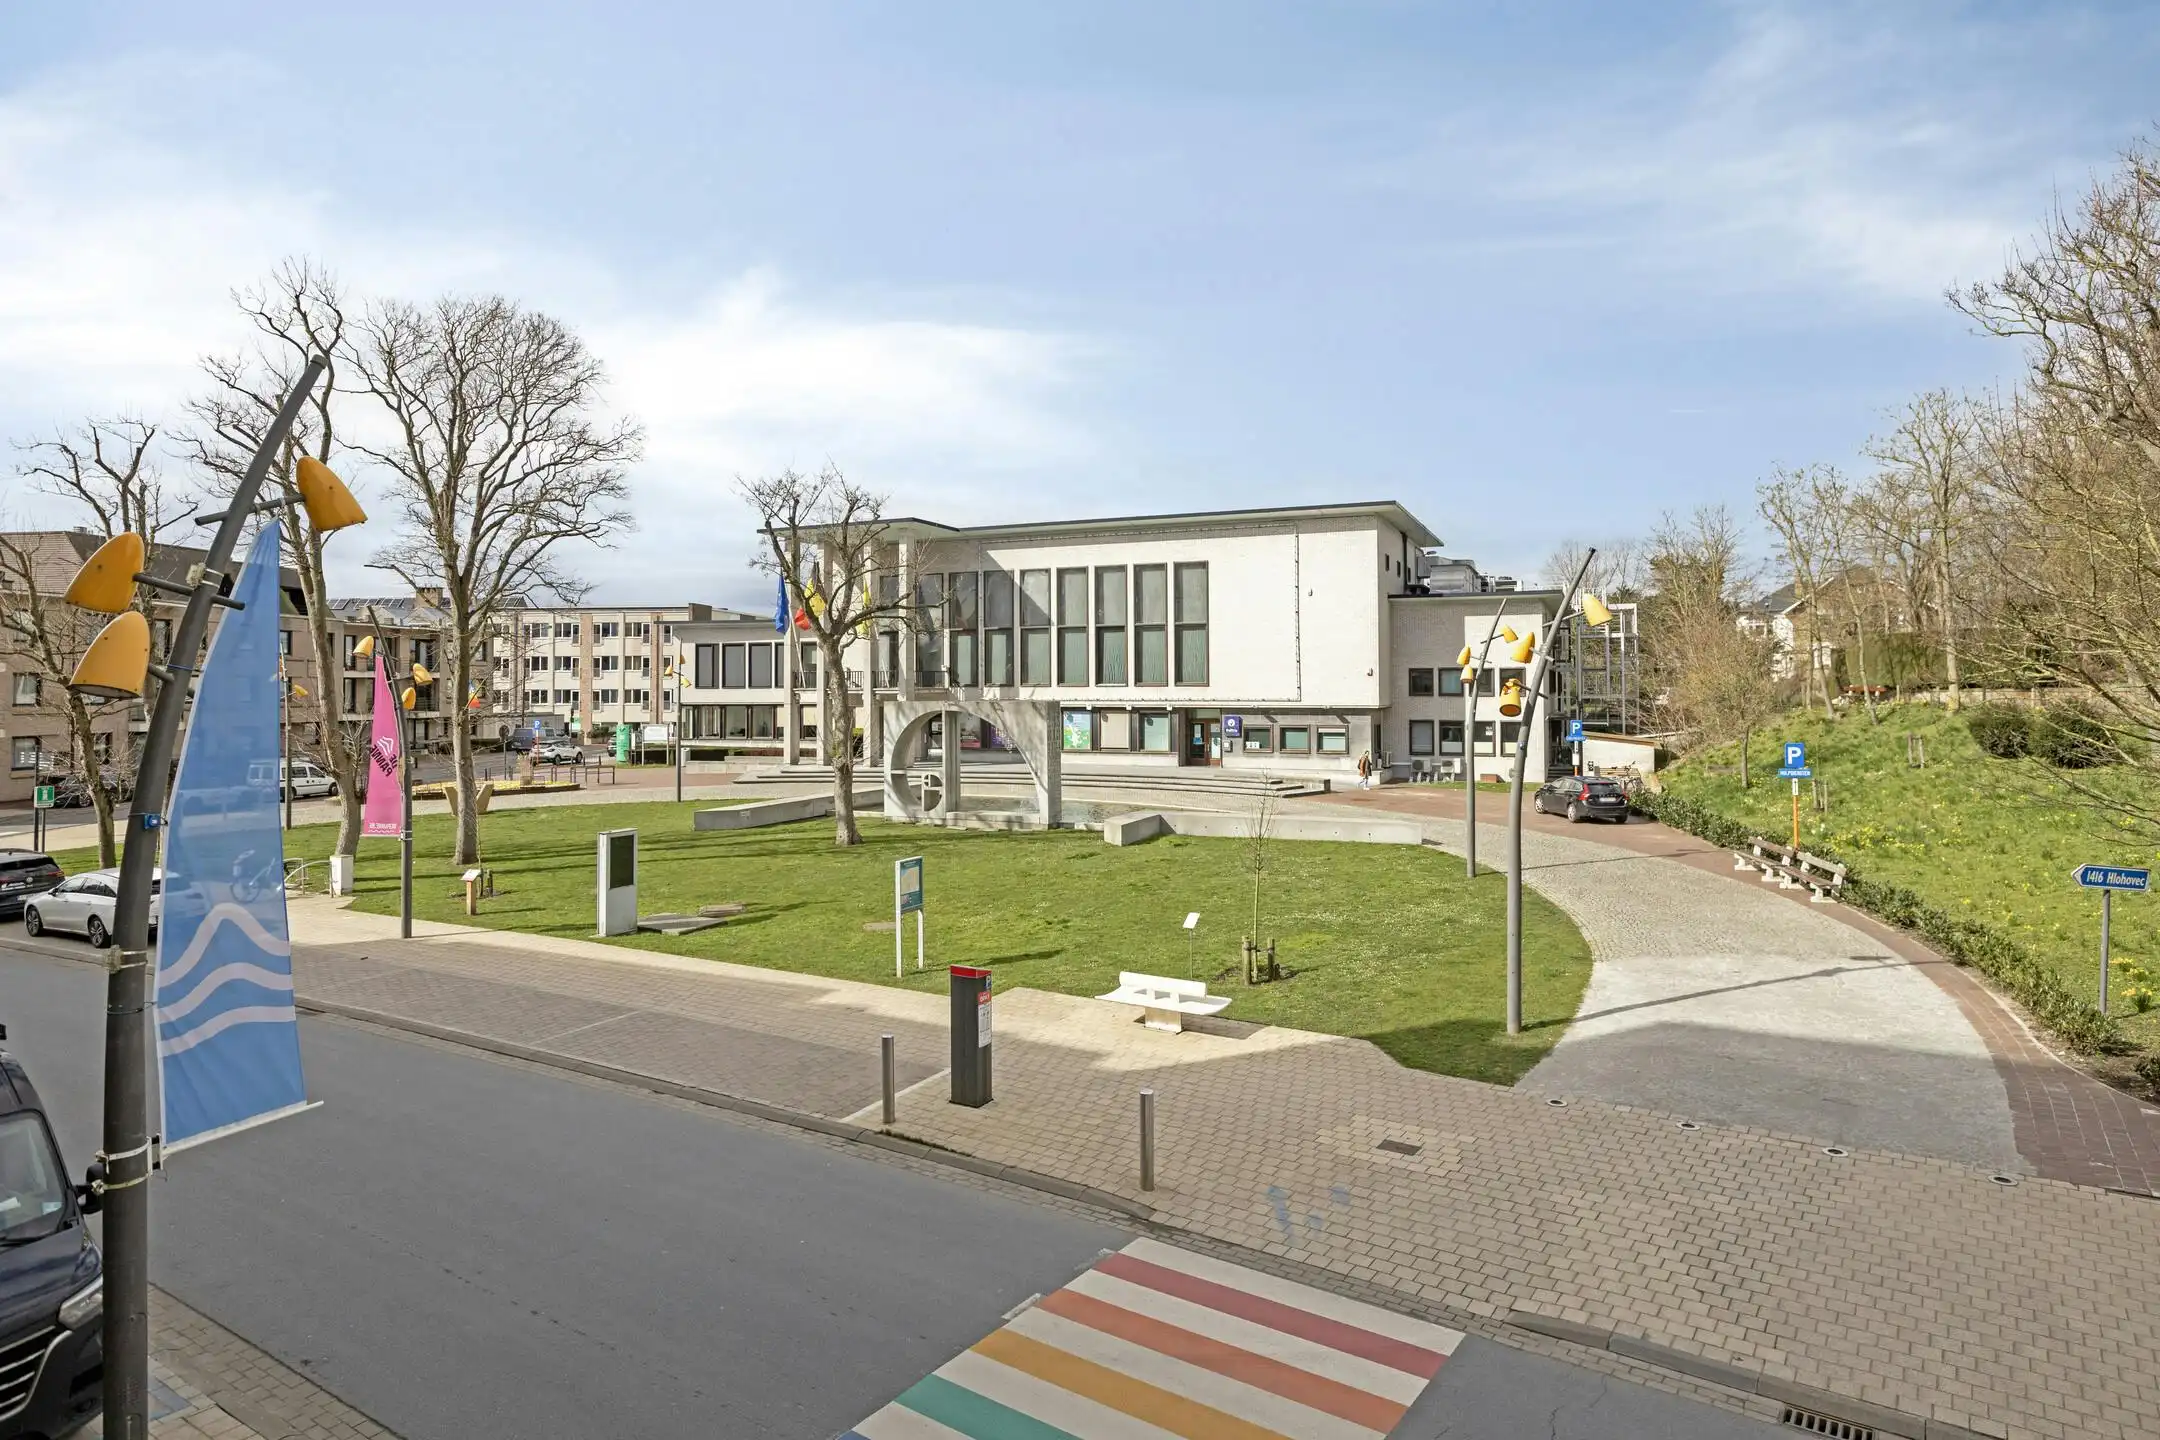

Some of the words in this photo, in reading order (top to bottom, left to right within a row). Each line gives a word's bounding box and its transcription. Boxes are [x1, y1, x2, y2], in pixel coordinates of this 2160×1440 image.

[1572, 722, 1580, 734] P
[1787, 746, 1802, 765] P
[2086, 870, 2104, 883] 1416
[2106, 871, 2146, 886] Hlohovec
